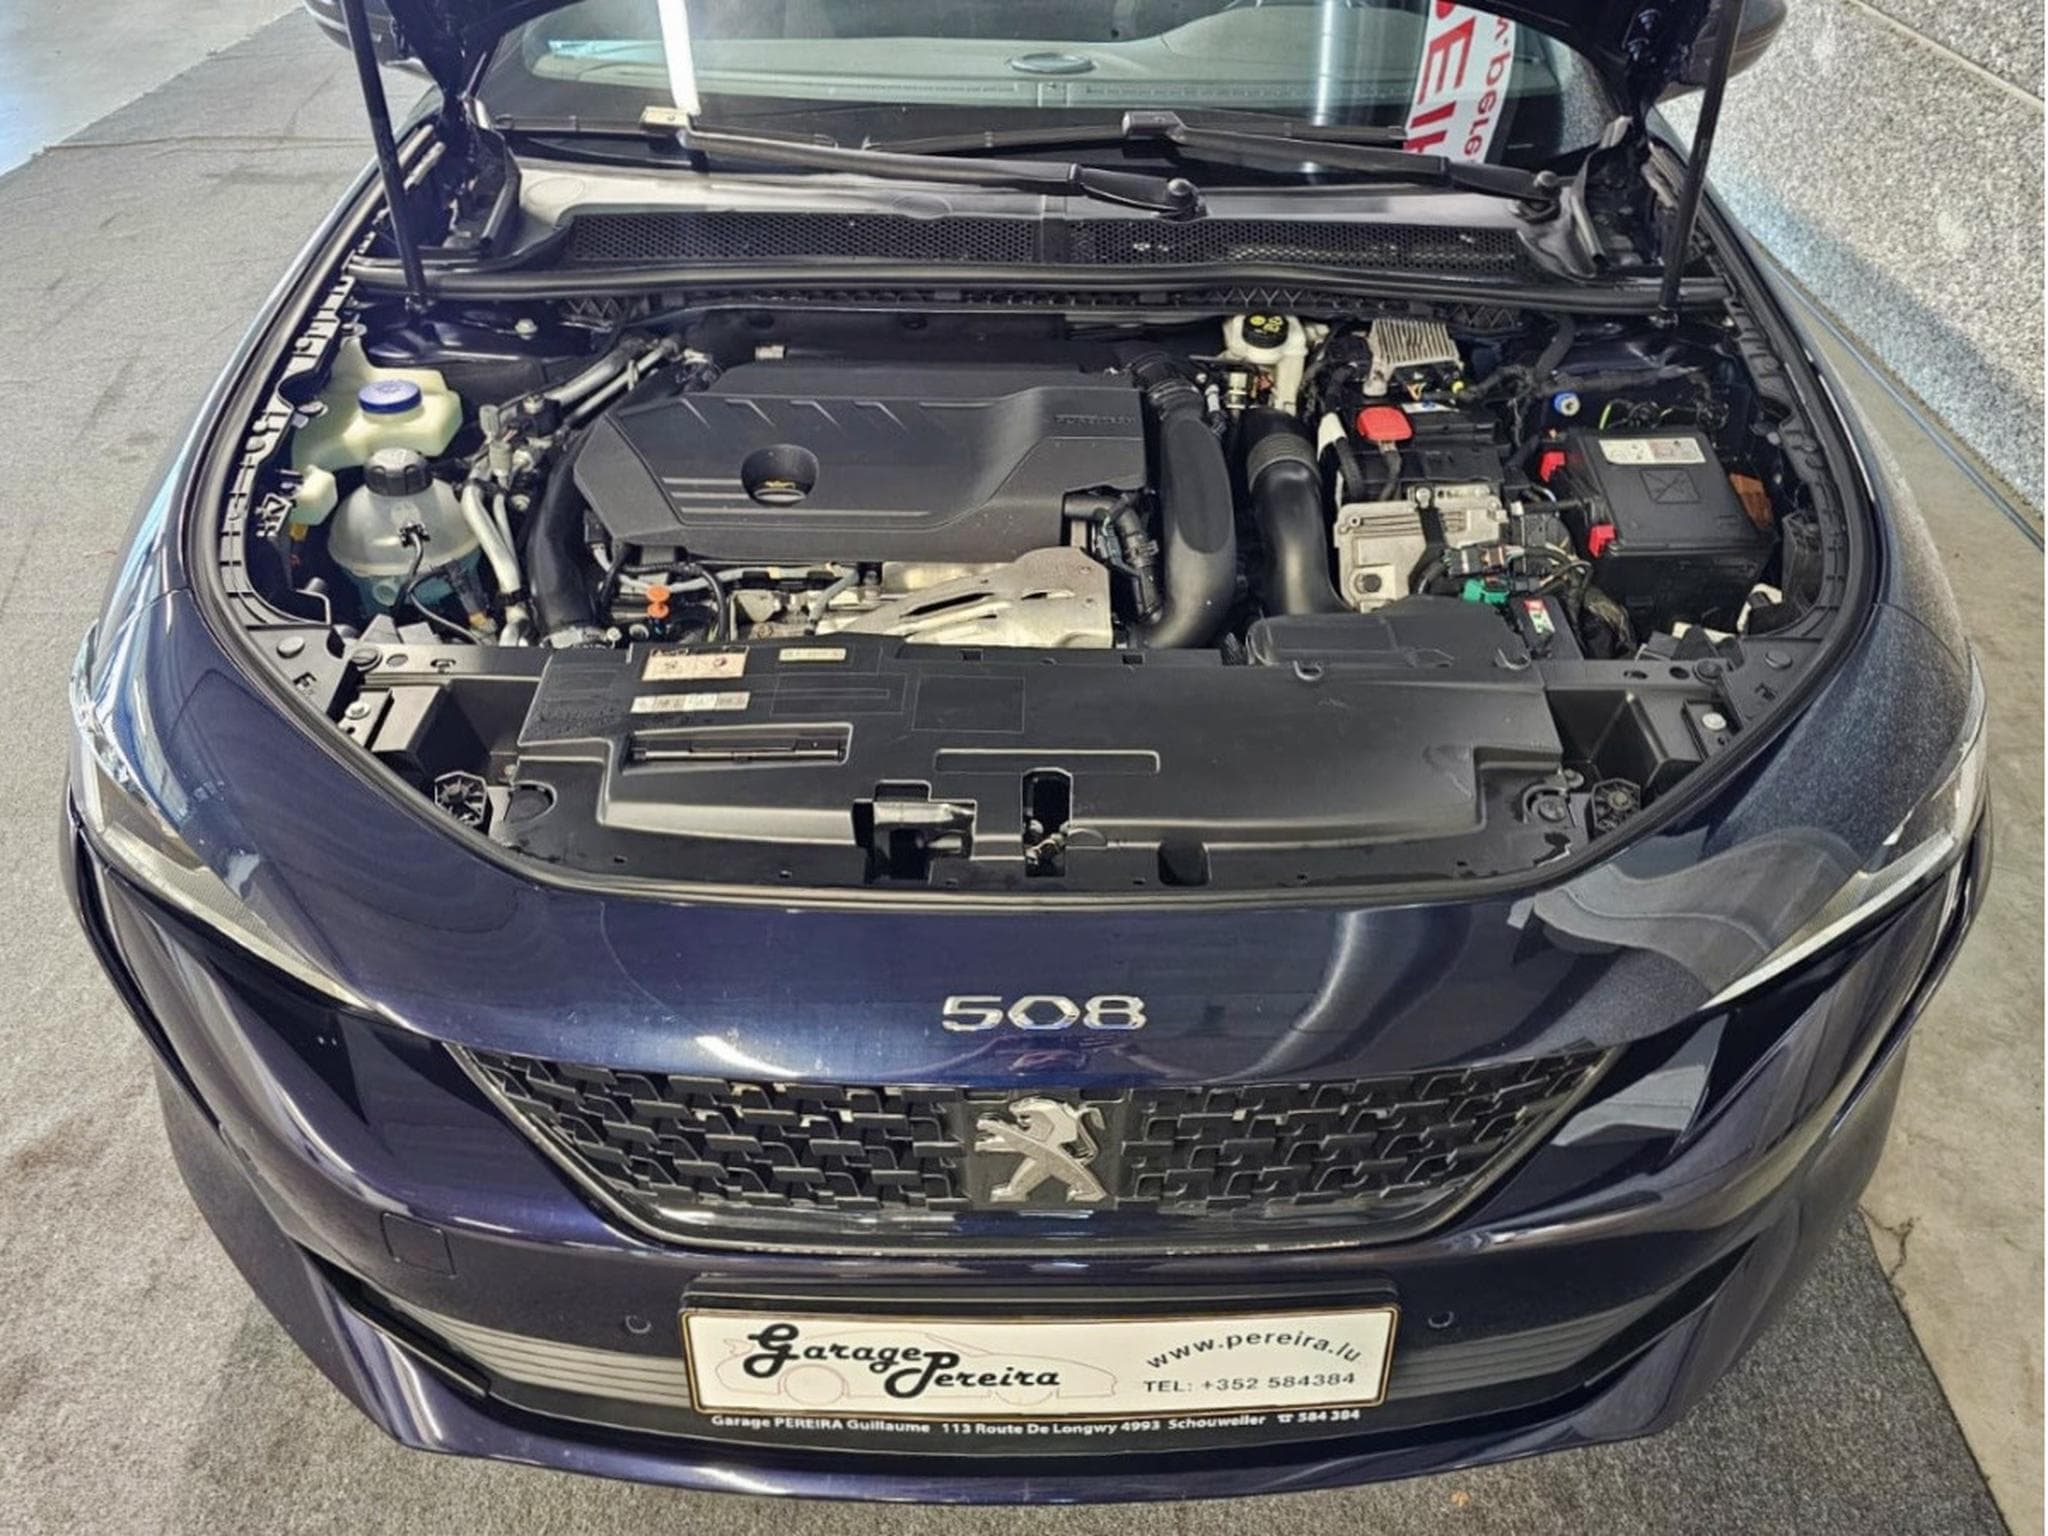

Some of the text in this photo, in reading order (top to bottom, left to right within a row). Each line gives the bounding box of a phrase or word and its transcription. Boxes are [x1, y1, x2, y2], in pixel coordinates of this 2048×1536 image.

[942, 995, 1147, 1032] 508
[742, 1322, 925, 1379] Garage
[1146, 1330, 1361, 1370] www.pereira.lu
[883, 1351, 1061, 1399] Pereira
[1143, 1372, 1355, 1393] TEL: +352 584384
[711, 1415, 771, 1430] Garage
[774, 1417, 843, 1430] PEREIRA
[847, 1418, 931, 1433] Guillaume
[942, 1423, 971, 1434] 113
[975, 1423, 1024, 1435] Route
[1027, 1423, 1050, 1434] De
[1053, 1422, 1118, 1435] Longwy
[1121, 1420, 1161, 1432] 4993
[1297, 1411, 1328, 1423] 584
[1330, 1409, 1361, 1421] 384
